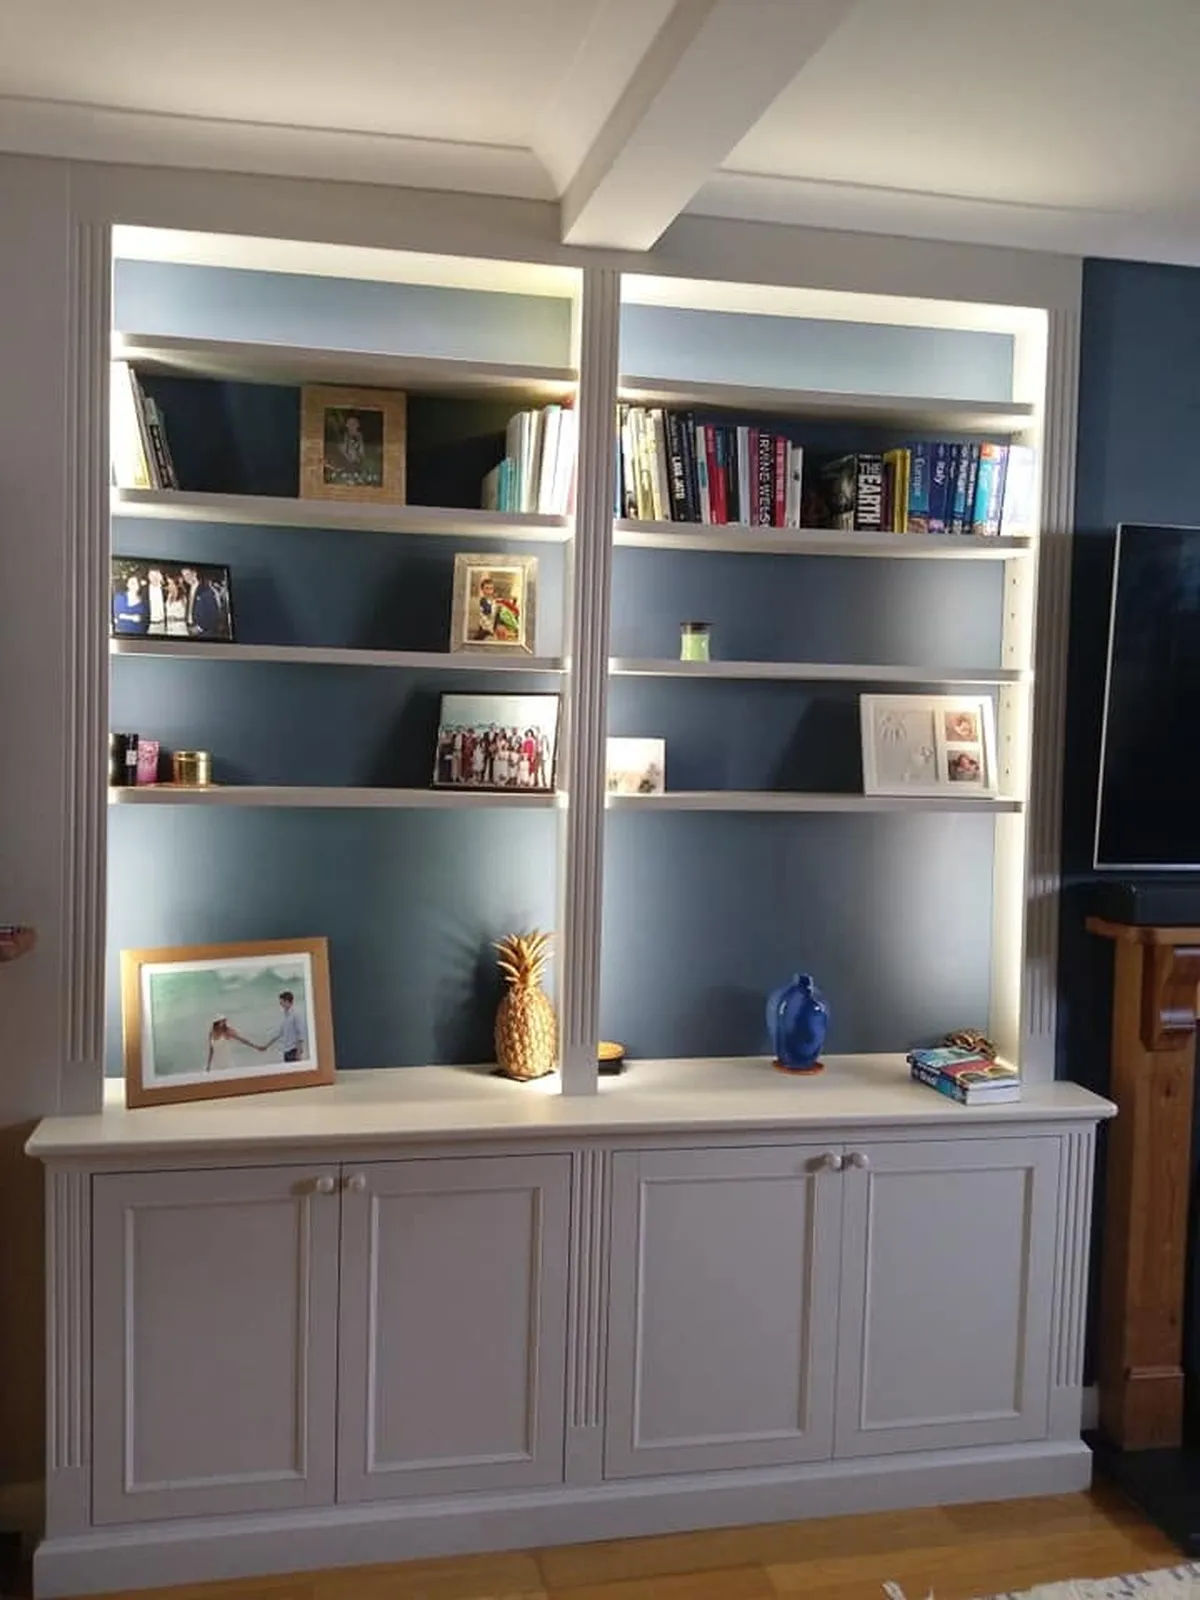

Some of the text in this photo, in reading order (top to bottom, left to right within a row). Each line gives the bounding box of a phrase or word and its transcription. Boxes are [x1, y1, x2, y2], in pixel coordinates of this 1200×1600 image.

[759, 433, 771, 481] IRVINE
[933, 461, 946, 486] Italy
[857, 474, 881, 524] EARTH
